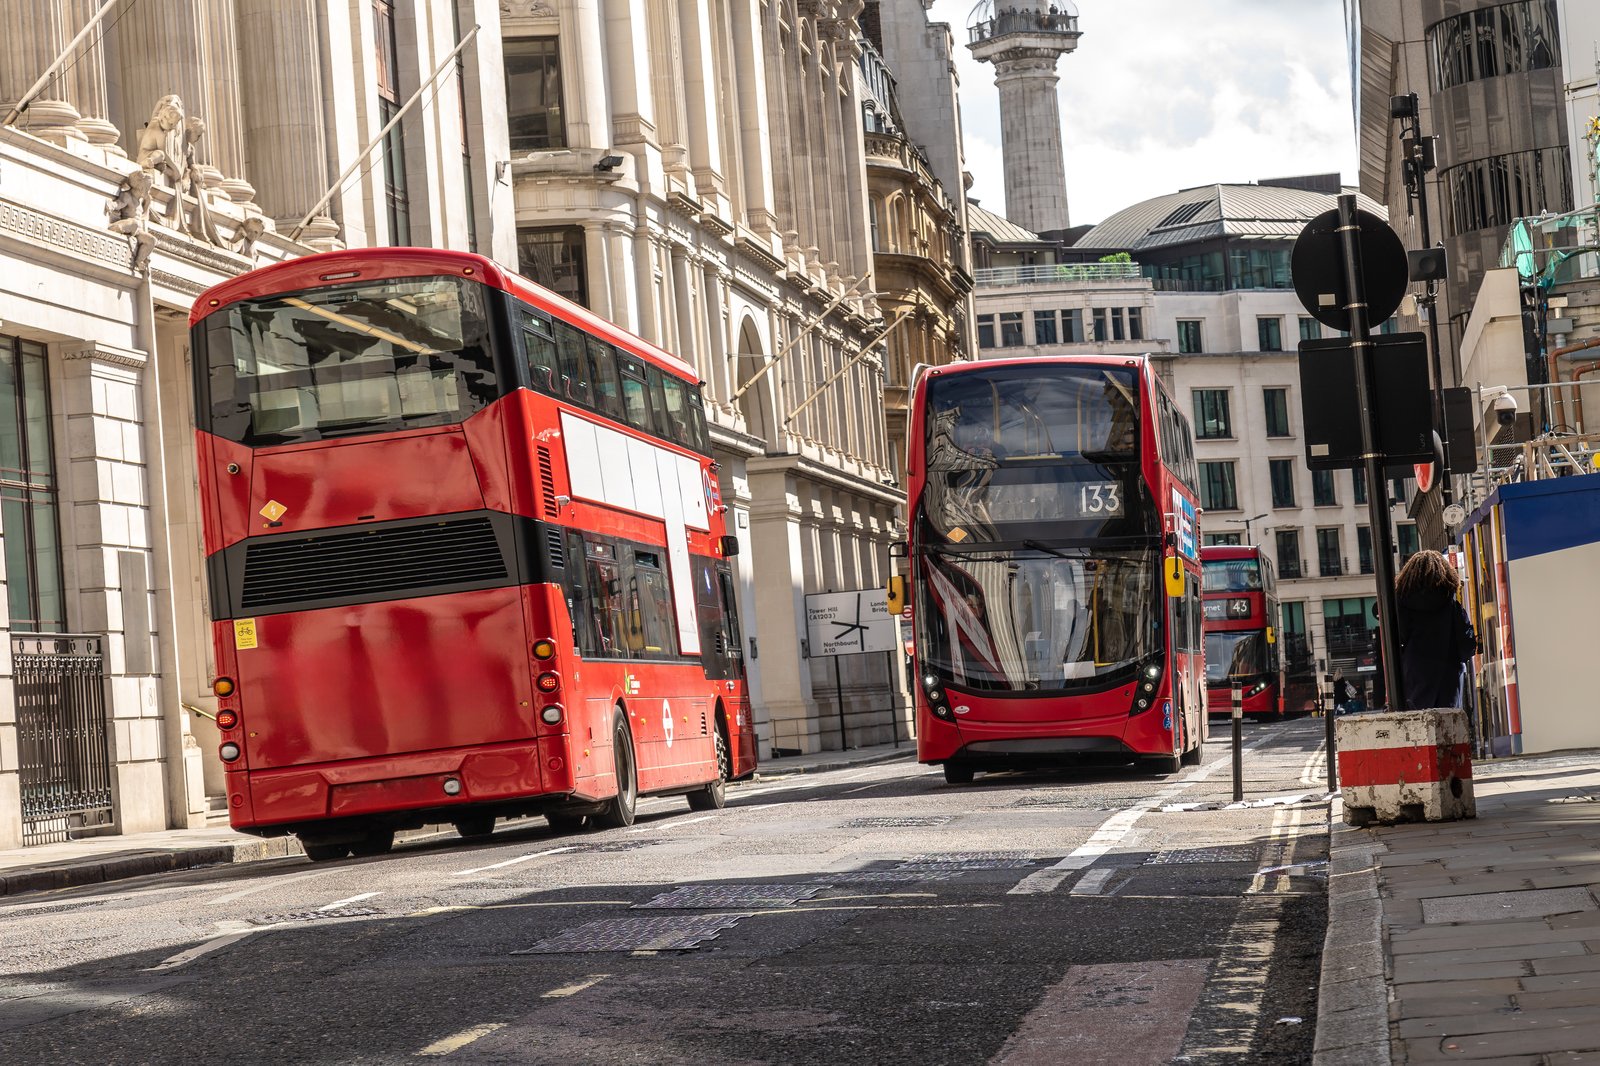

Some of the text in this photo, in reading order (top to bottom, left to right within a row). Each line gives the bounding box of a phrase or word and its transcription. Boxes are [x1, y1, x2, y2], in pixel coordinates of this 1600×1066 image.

[1081, 484, 1120, 512] 133
[1233, 600, 1247, 612] 43
[809, 613, 836, 621] (A1203)
[823, 640, 858, 648] Northbound
